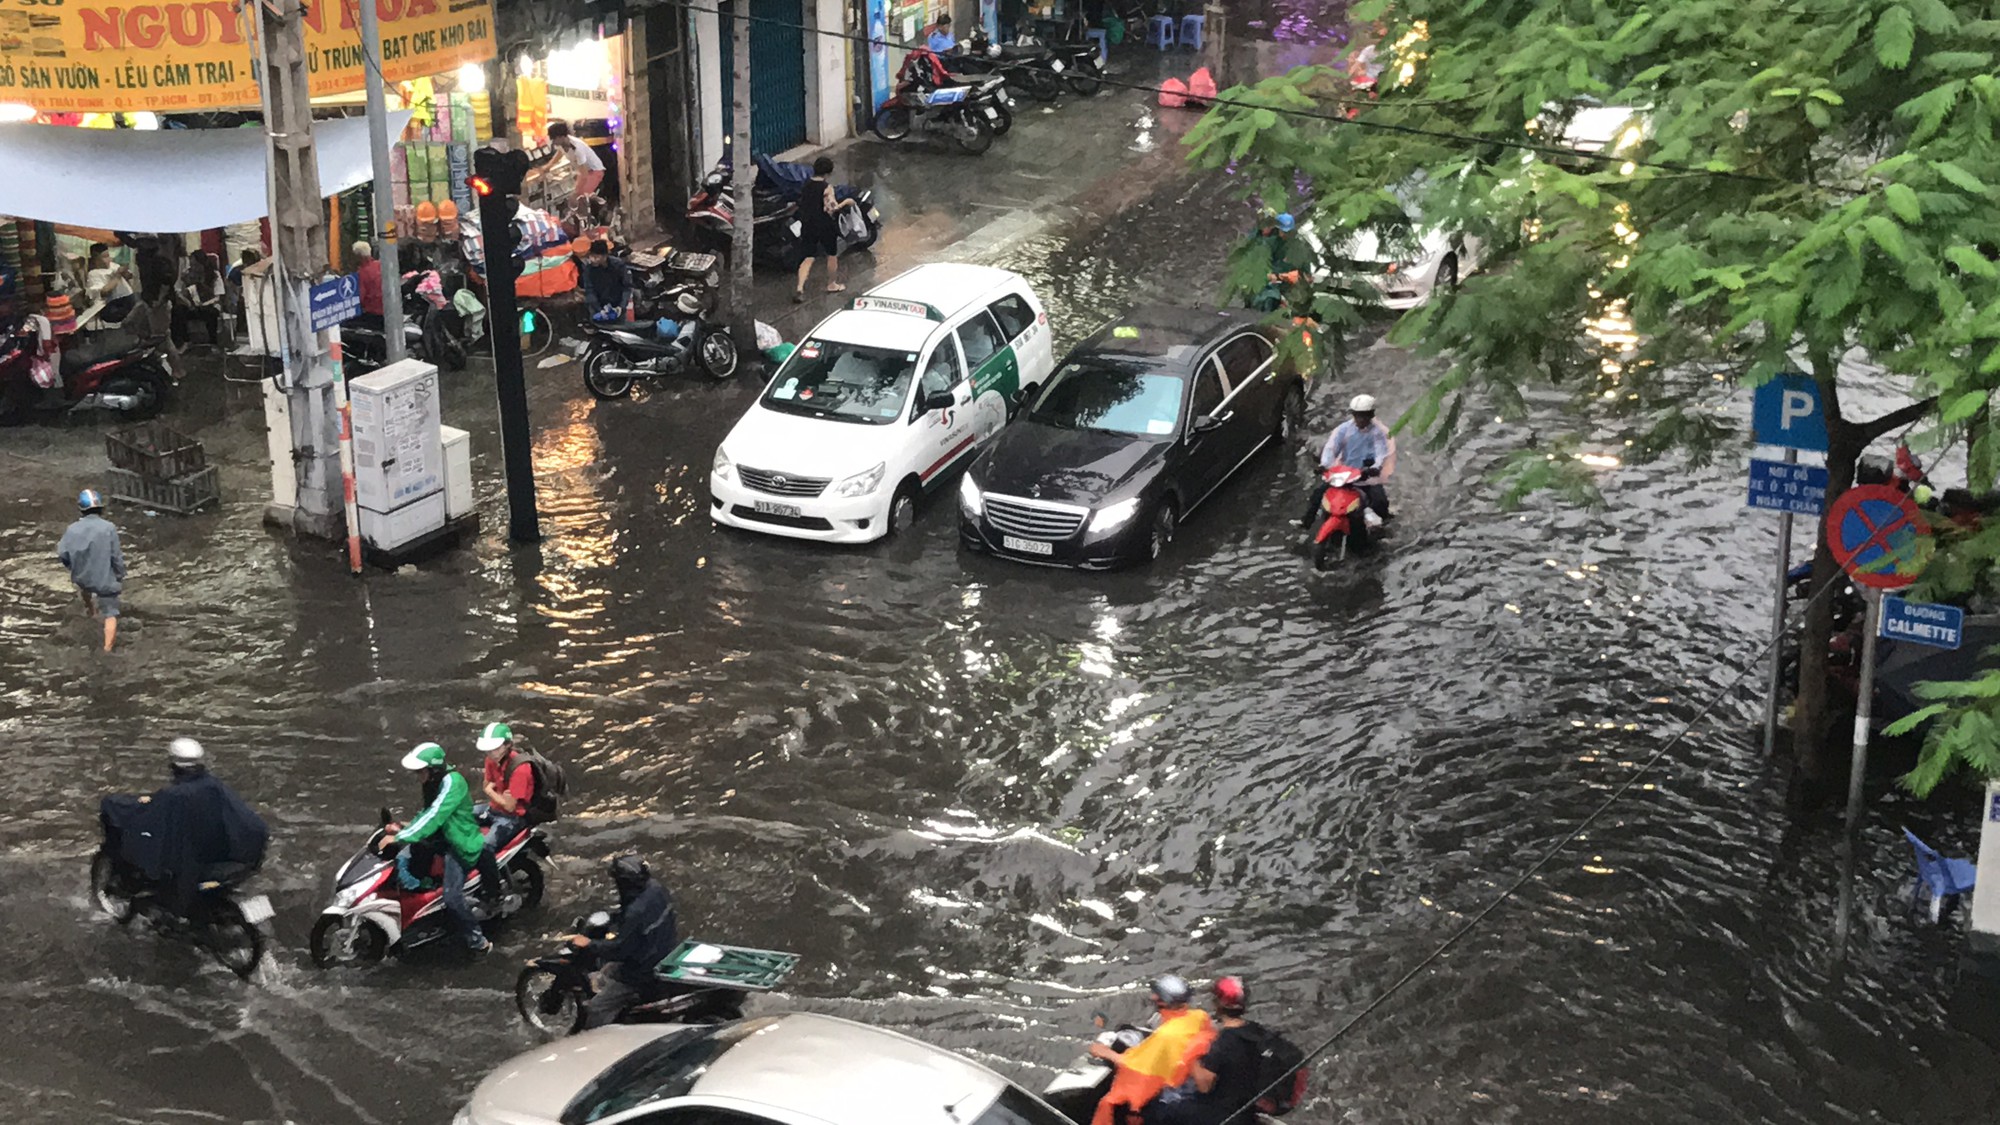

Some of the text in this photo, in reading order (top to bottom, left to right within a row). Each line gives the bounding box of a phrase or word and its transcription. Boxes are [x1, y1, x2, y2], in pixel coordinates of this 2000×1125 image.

[78, 0, 322, 50] NGUYN
[20, 60, 51, 88] SÂN
[115, 56, 147, 88] LỀU
[195, 60, 235, 88] TRẠI
[324, 41, 364, 68] TRÙN
[383, 35, 408, 62] BẠT
[1781, 389, 1814, 430] P
[1887, 618, 1957, 642] CALMETTE
